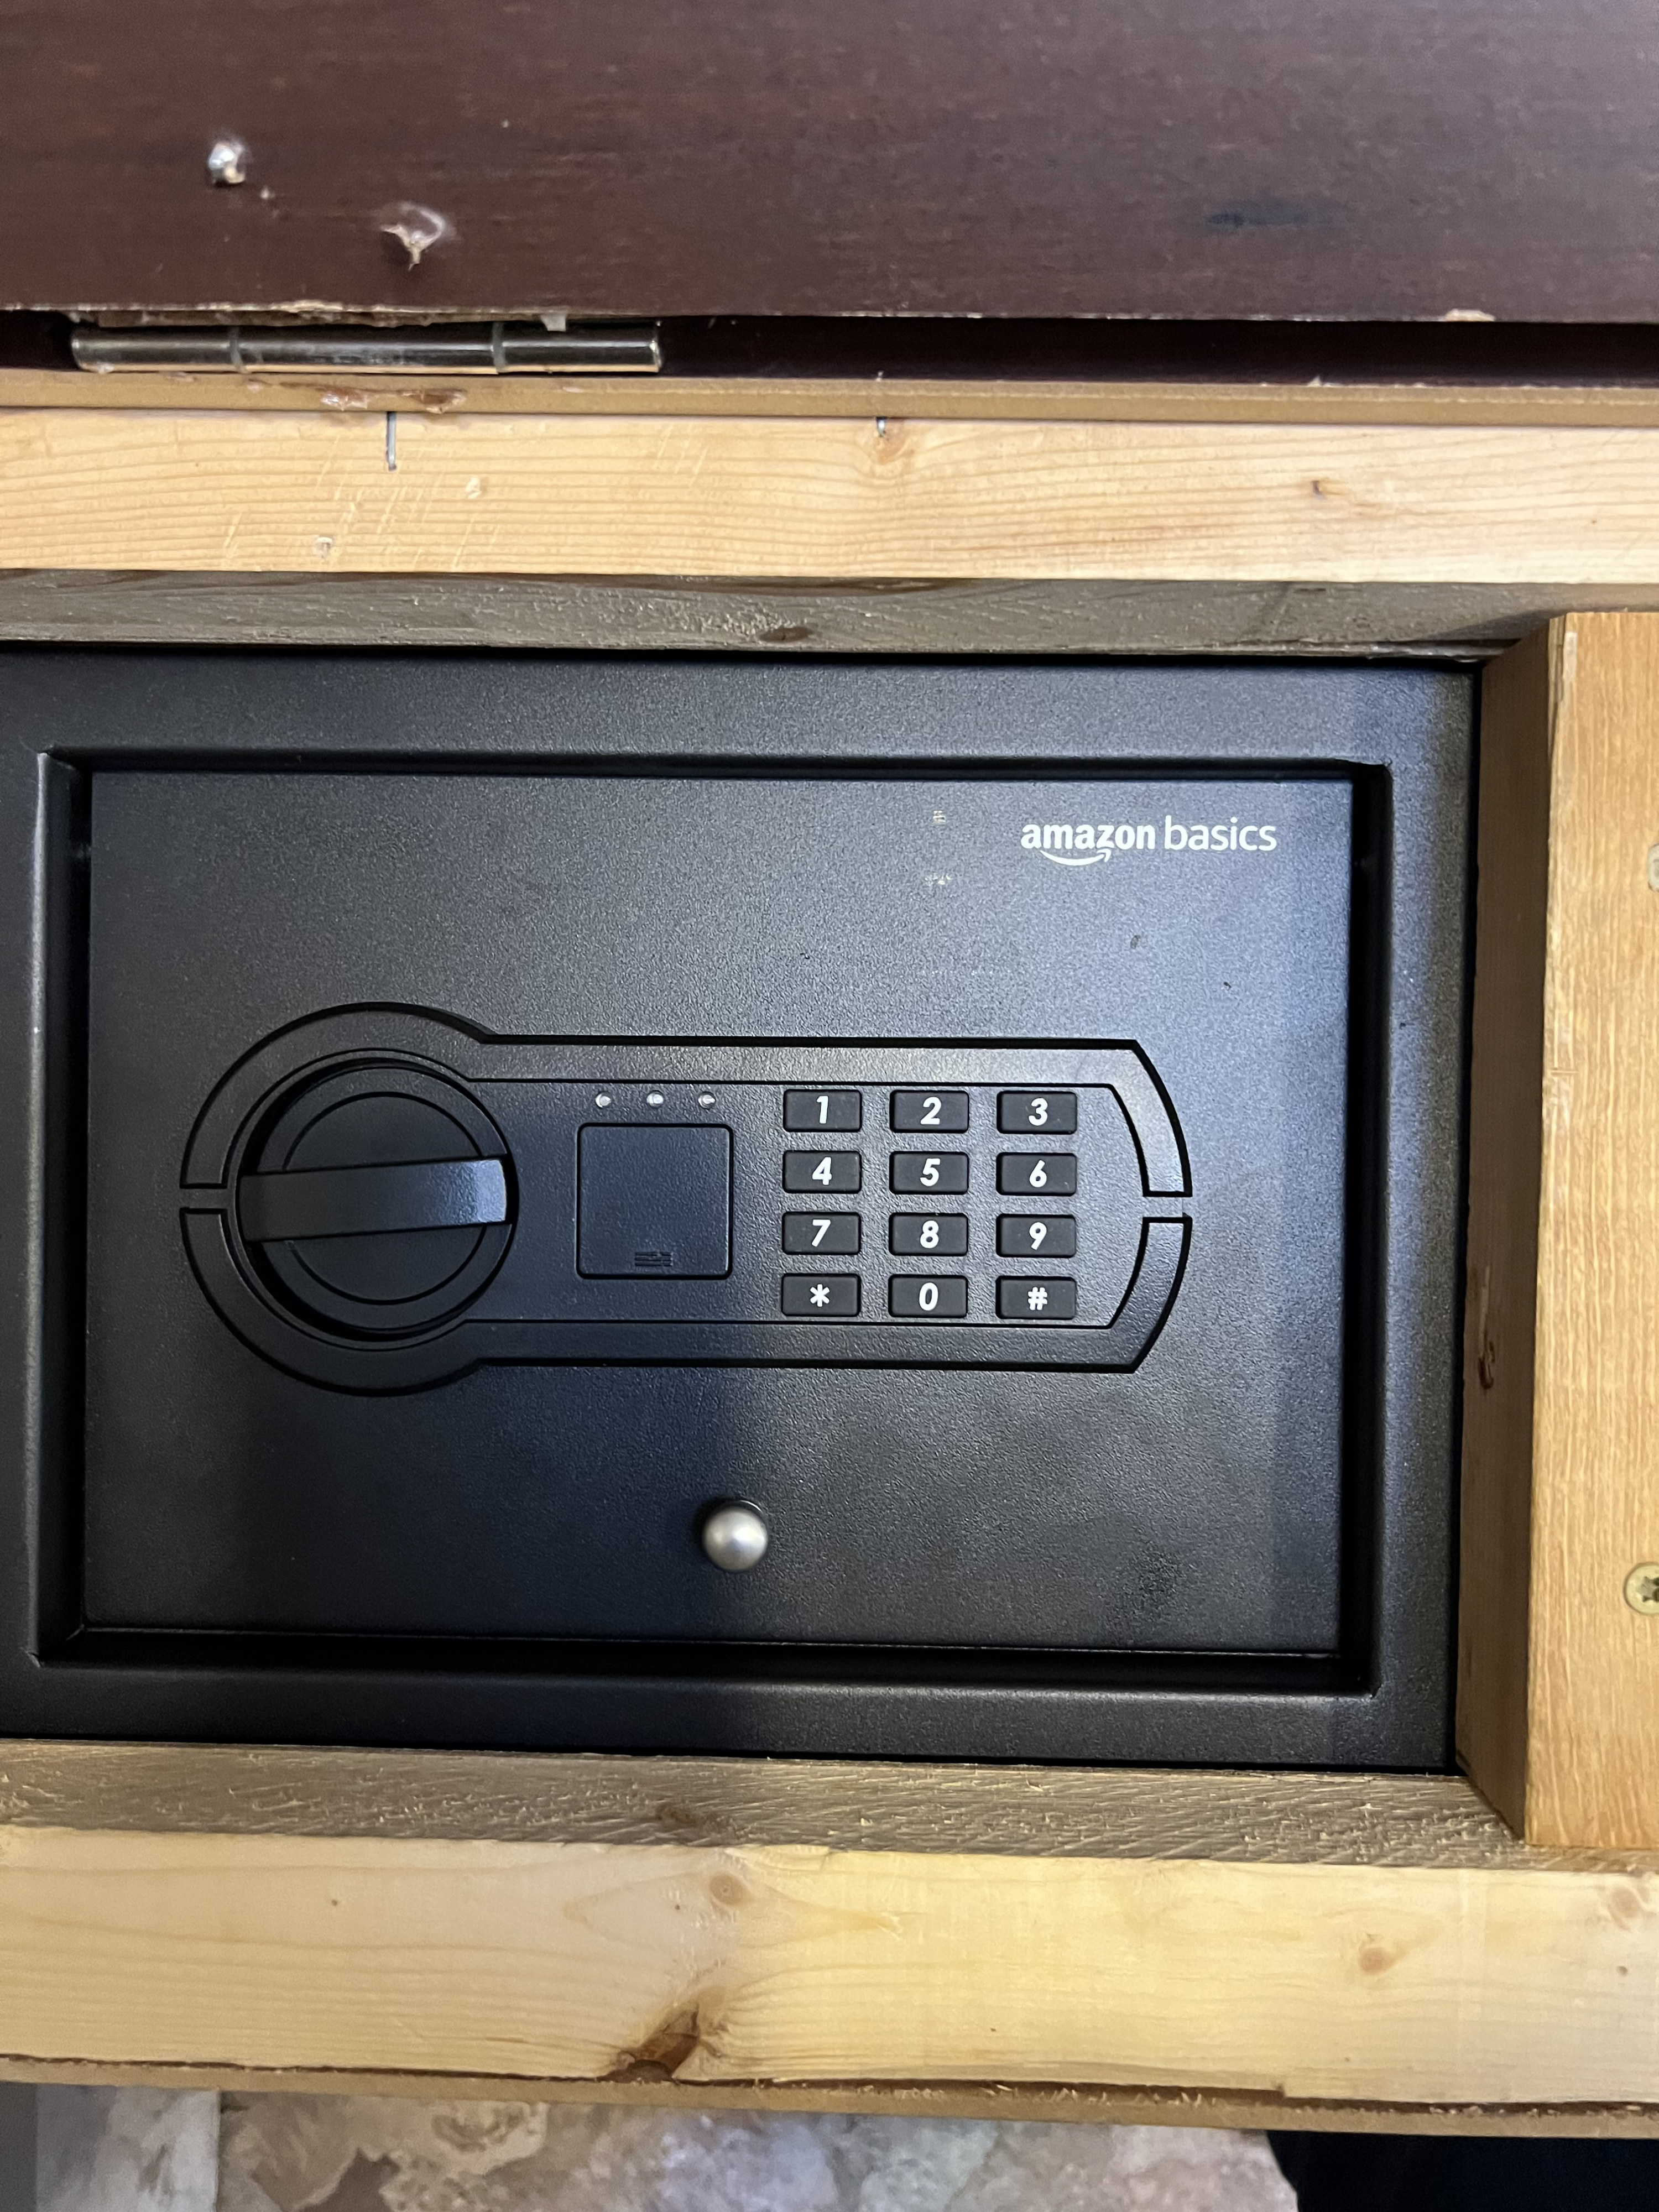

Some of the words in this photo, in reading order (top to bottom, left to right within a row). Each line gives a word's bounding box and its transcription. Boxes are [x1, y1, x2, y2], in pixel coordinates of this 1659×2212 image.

[1020, 824, 1156, 849] amazon
[1164, 815, 1277, 851] basics
[816, 1095, 828, 1124] 1
[920, 1097, 942, 1125] 2
[1028, 1098, 1048, 1126] 3
[812, 1157, 832, 1186] 4
[920, 1158, 941, 1187] 5
[1029, 1160, 1047, 1188] 6
[811, 1219, 831, 1247] 7
[920, 1220, 939, 1249] 8
[1029, 1222, 1047, 1250] 9
[919, 1282, 938, 1311] 0
[1027, 1286, 1048, 1311] #
